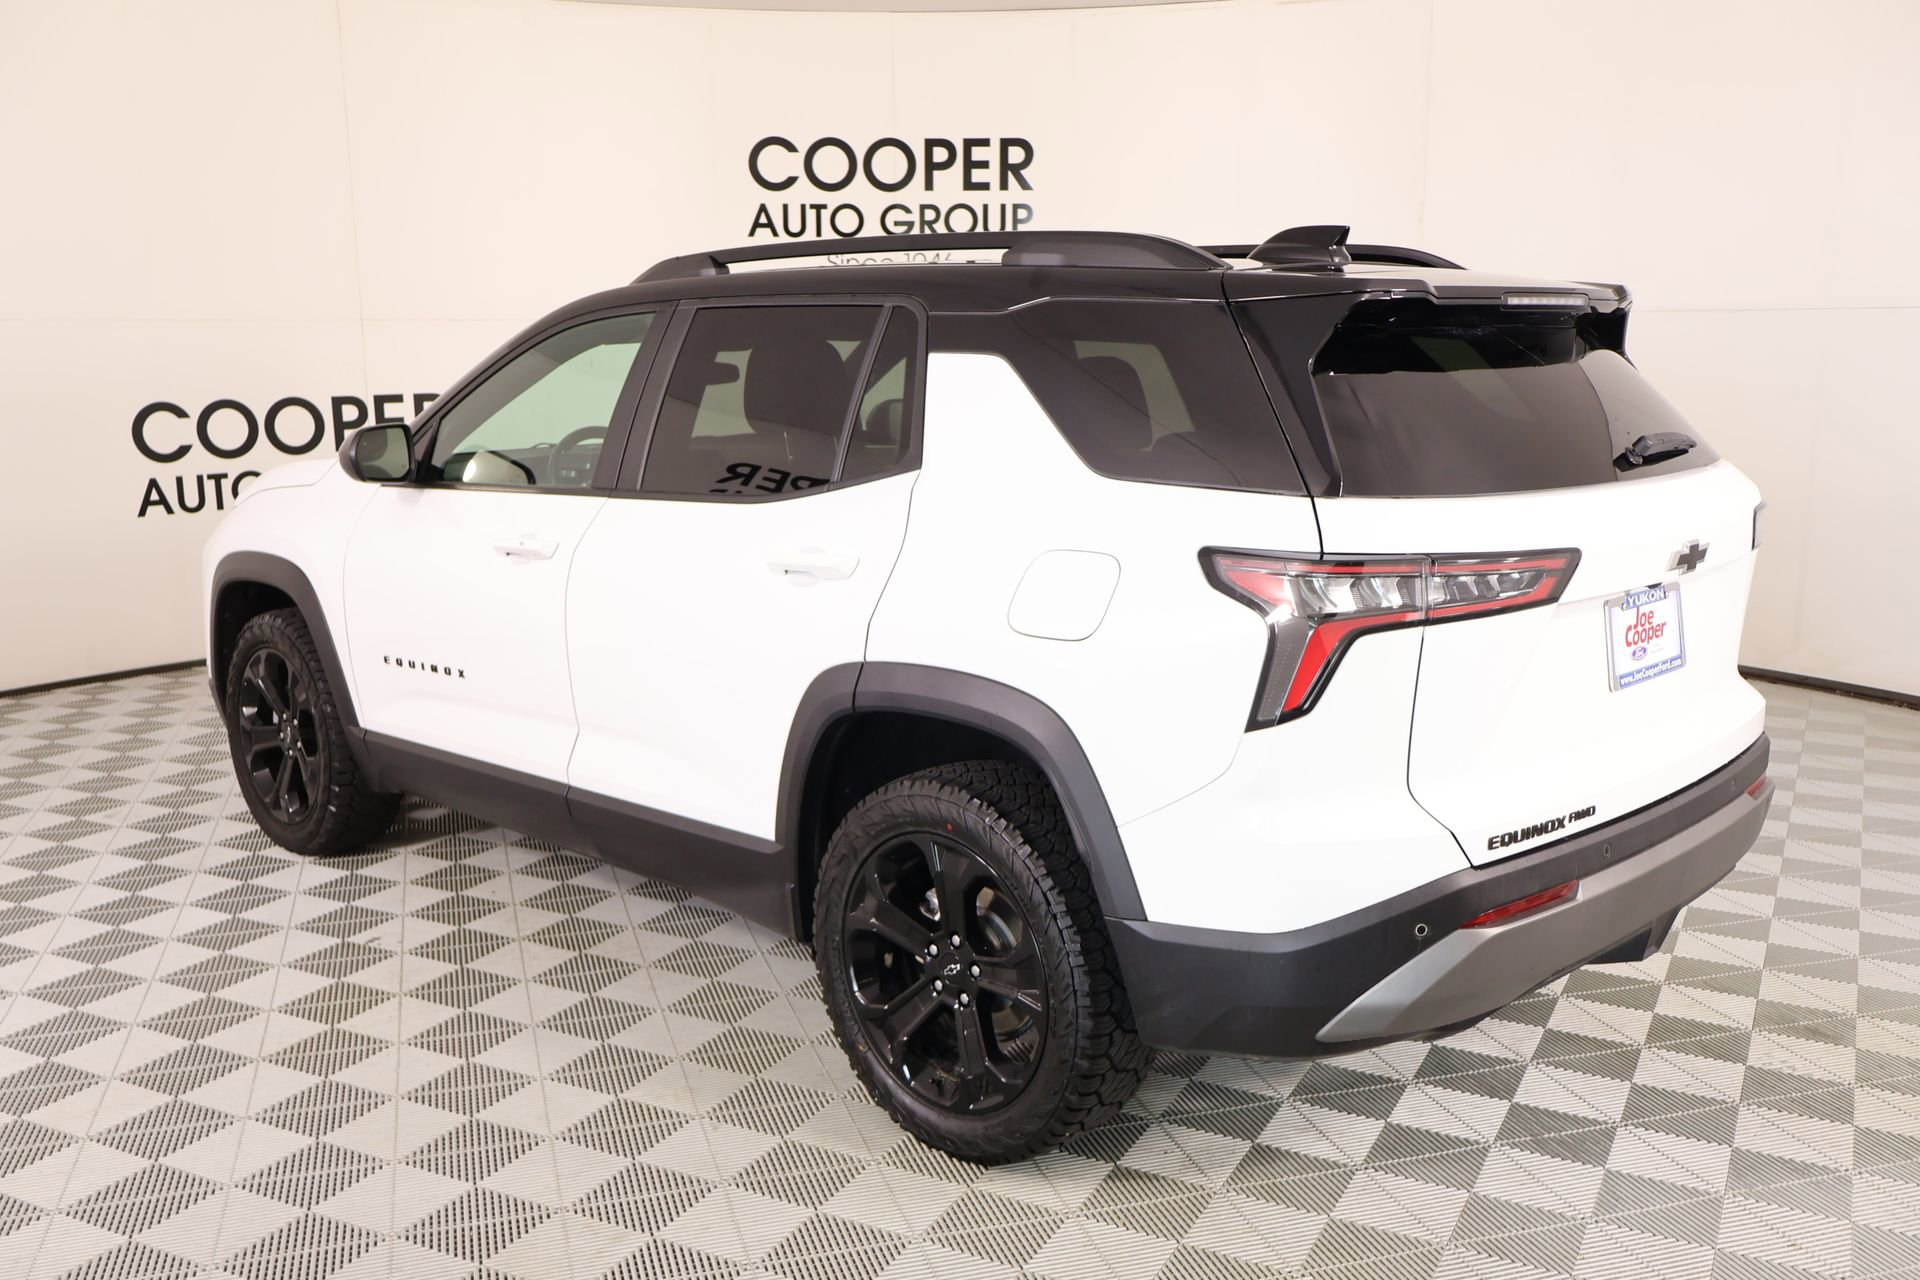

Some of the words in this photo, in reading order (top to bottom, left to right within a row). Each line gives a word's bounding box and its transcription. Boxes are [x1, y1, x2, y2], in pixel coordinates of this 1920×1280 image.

[749, 136, 1034, 192] COOPER
[748, 203, 865, 238] AUTO
[880, 203, 1034, 235] GROUP
[1628, 589, 1665, 607] YUKON
[1633, 606, 1654, 630] Joe
[1625, 622, 1666, 647] Cooper
[384, 655, 465, 679] EQUINOX
[1488, 815, 1566, 850] EQUINOX
[1568, 805, 1596, 823] AWD
